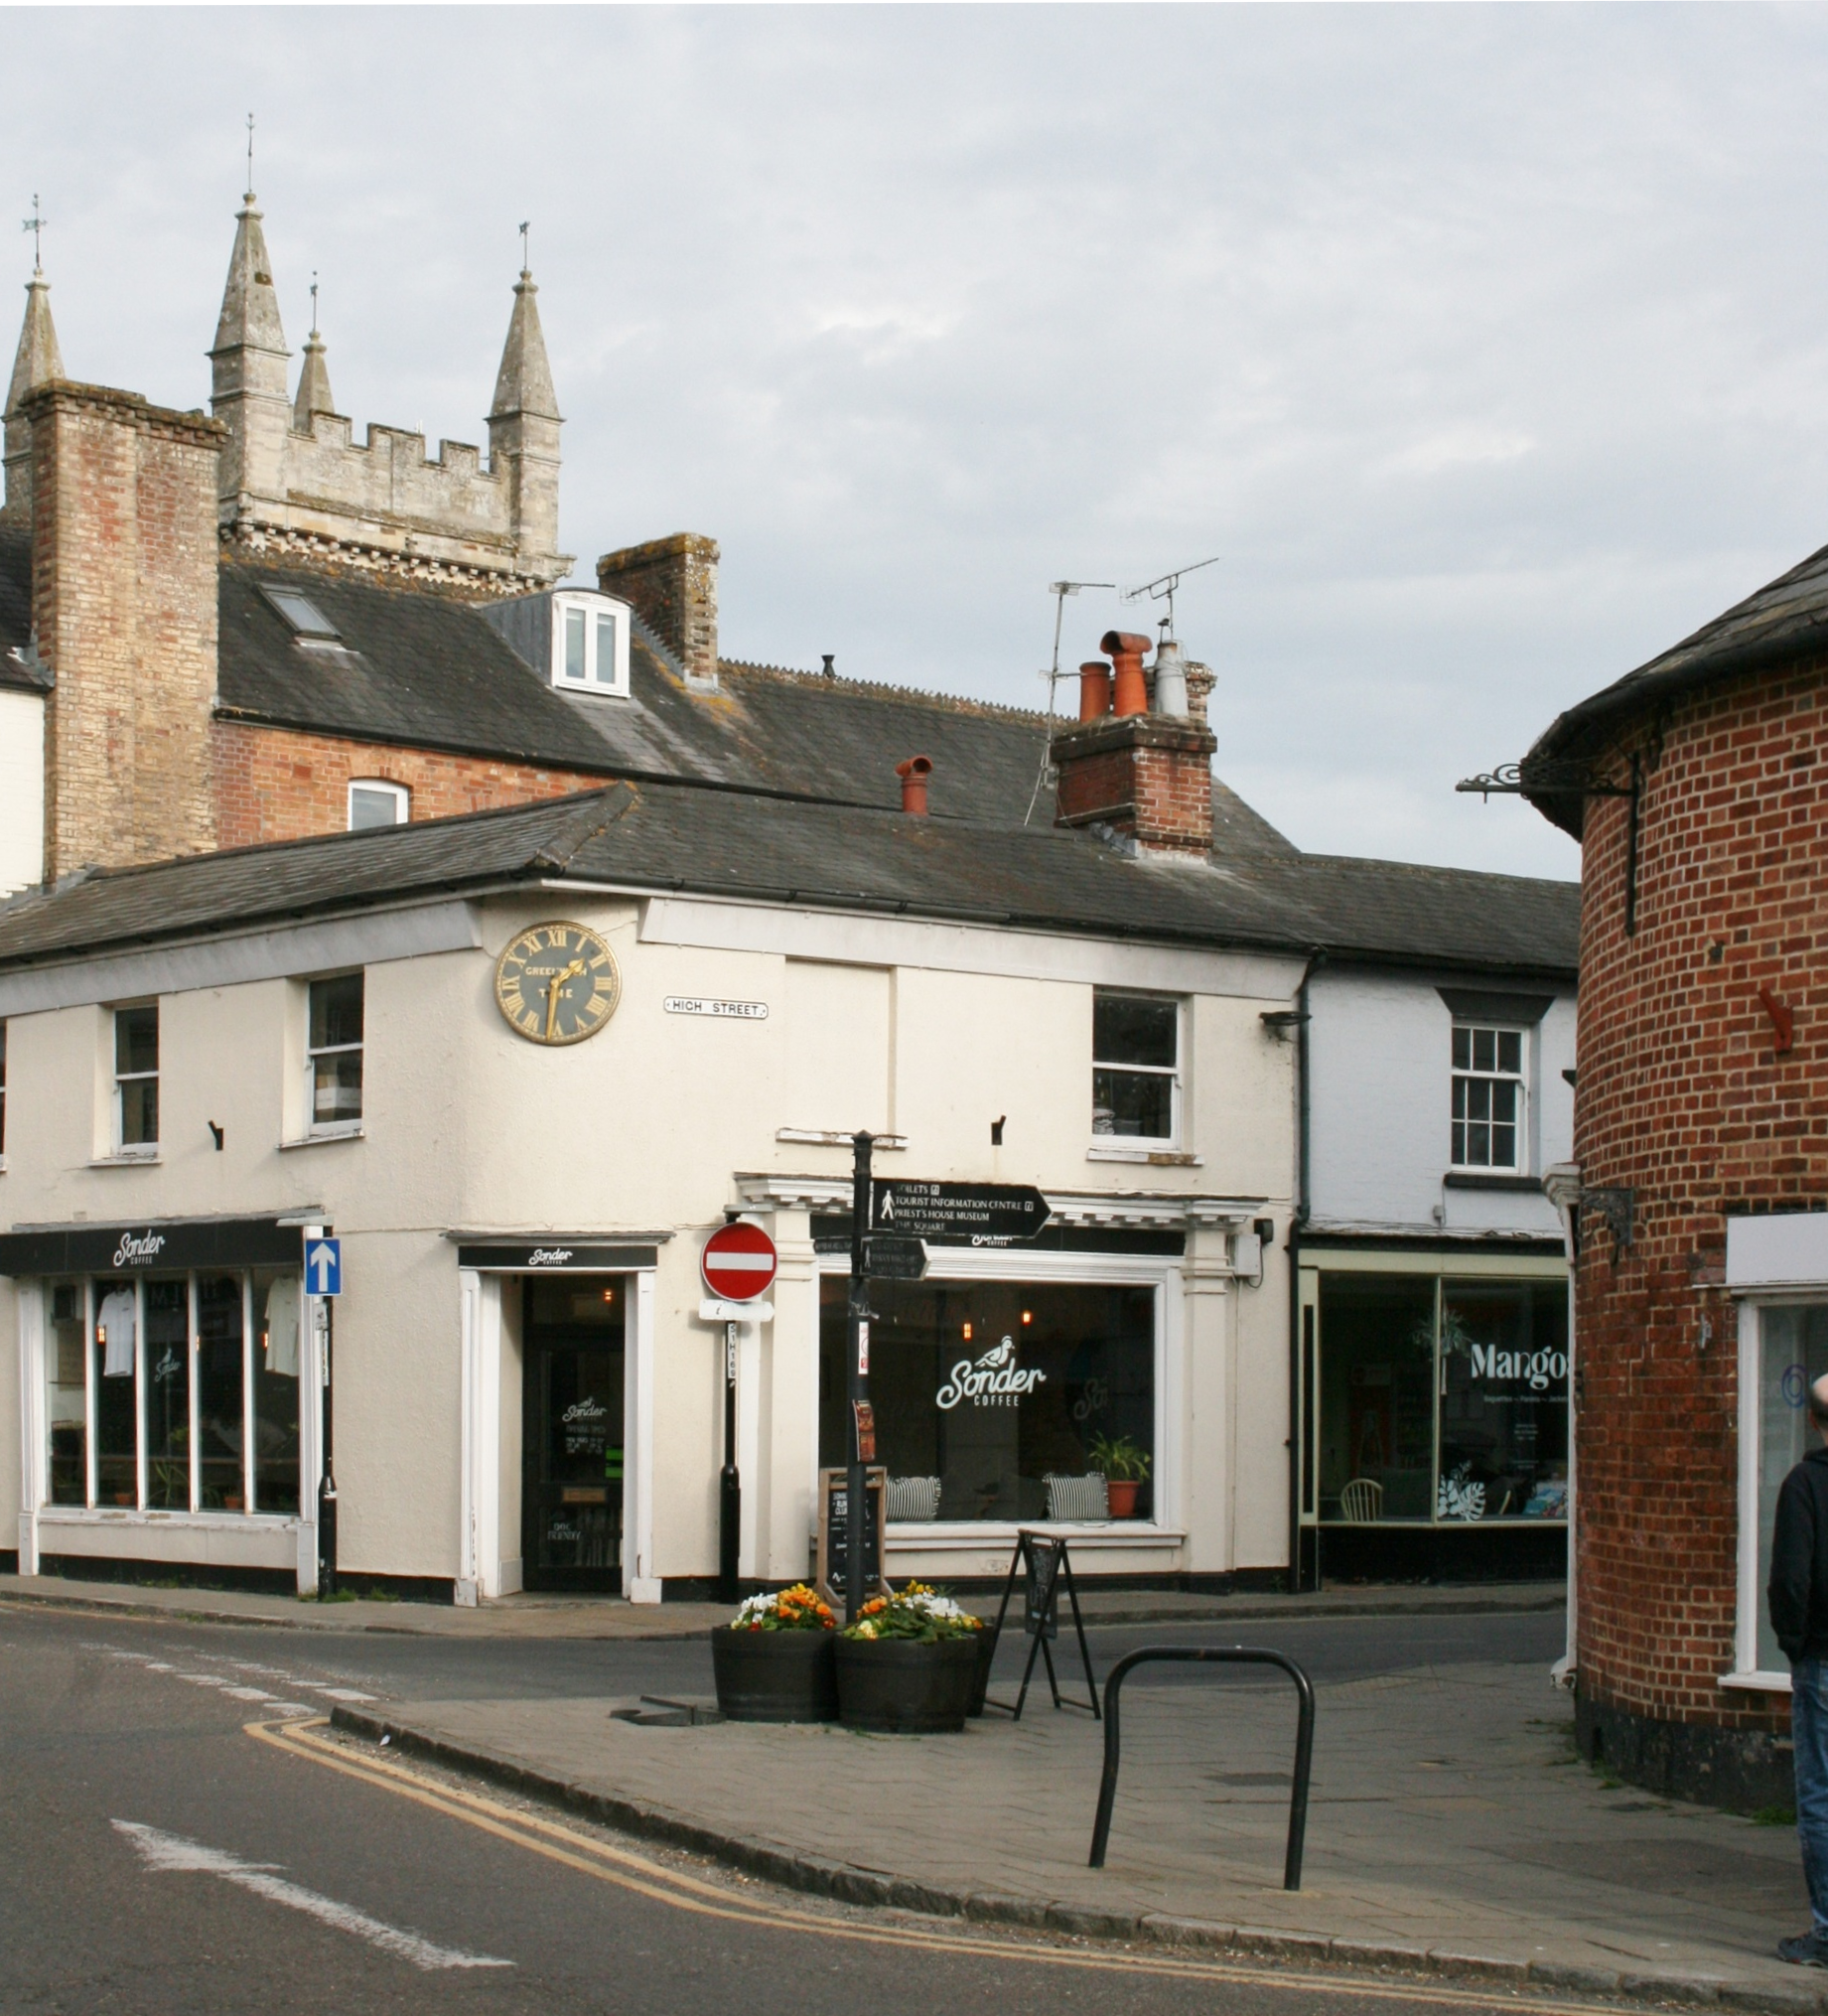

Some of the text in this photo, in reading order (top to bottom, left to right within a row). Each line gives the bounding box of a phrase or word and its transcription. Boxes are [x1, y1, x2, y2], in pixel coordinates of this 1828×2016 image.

[525, 966, 588, 976] GREEH
[538, 988, 573, 998] TE
[673, 999, 702, 1011] HIGH
[896, 1196, 929, 1206] TOURIST
[930, 1198, 988, 1210] INFORMATION
[894, 1208, 990, 1222] PRIEST'S HOUSE MUSEUM
[914, 1222, 946, 1231] SQUARE
[113, 1229, 165, 1267] Sonder
[130, 1256, 153, 1265] COFFEE
[528, 1247, 573, 1265] Sonder
[1472, 1344, 1569, 1390] Mango
[935, 1357, 1047, 1410] Sonder
[974, 1394, 1020, 1406] COFFEE
[562, 1404, 608, 1422] Sonder
